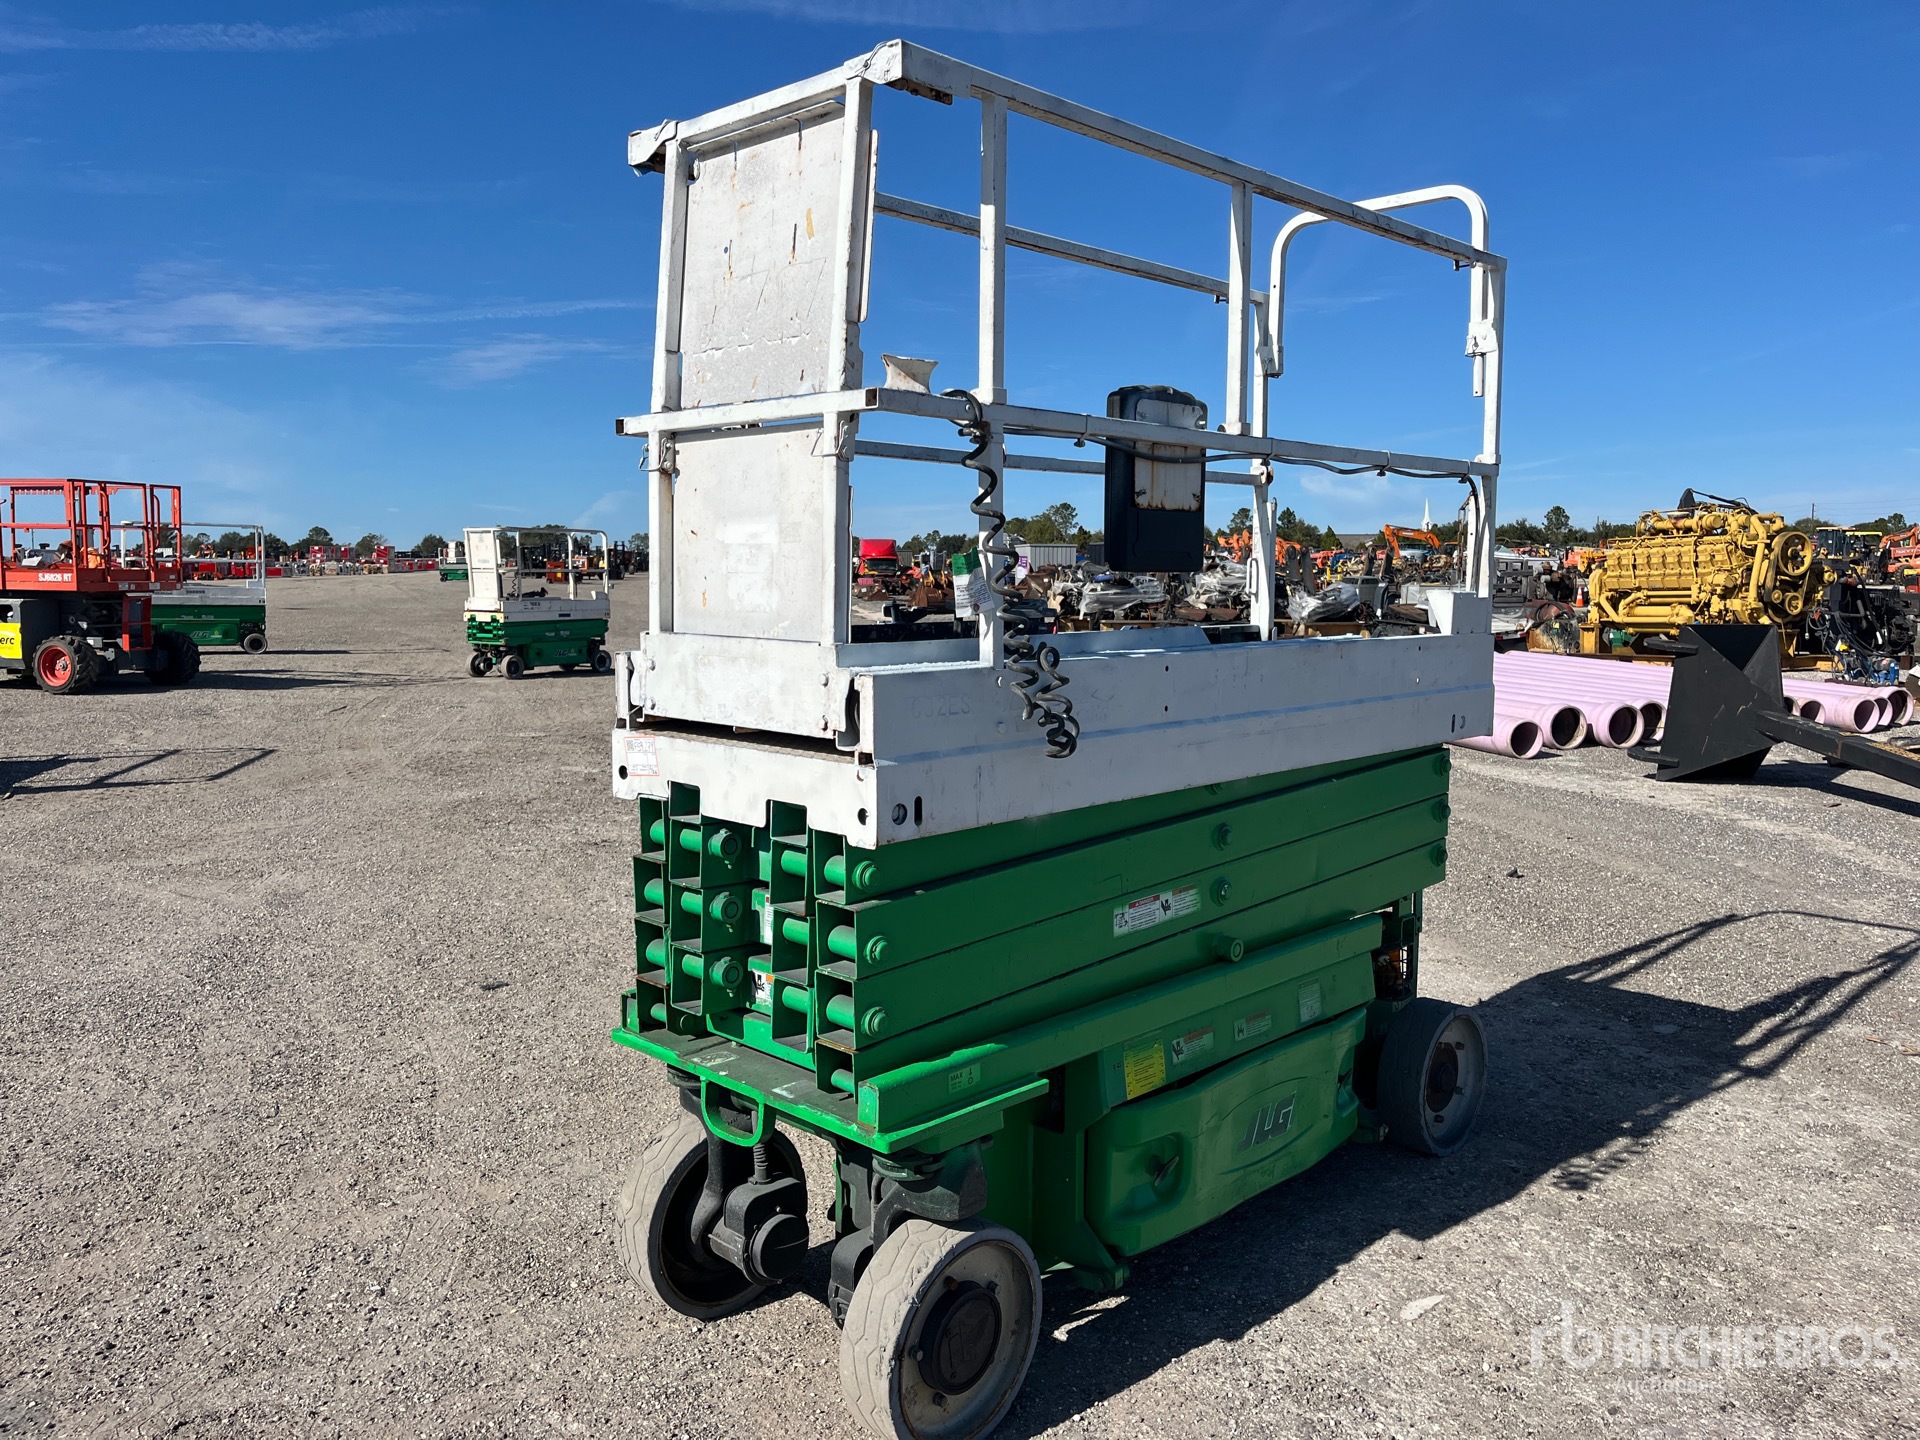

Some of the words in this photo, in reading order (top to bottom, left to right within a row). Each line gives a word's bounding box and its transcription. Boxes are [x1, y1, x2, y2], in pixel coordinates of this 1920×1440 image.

[38, 573, 62, 582] SJ6826
[63, 573, 73, 582] RT
[950, 1071, 963, 1082] MAX
[1236, 1090, 1297, 1154] JLG
